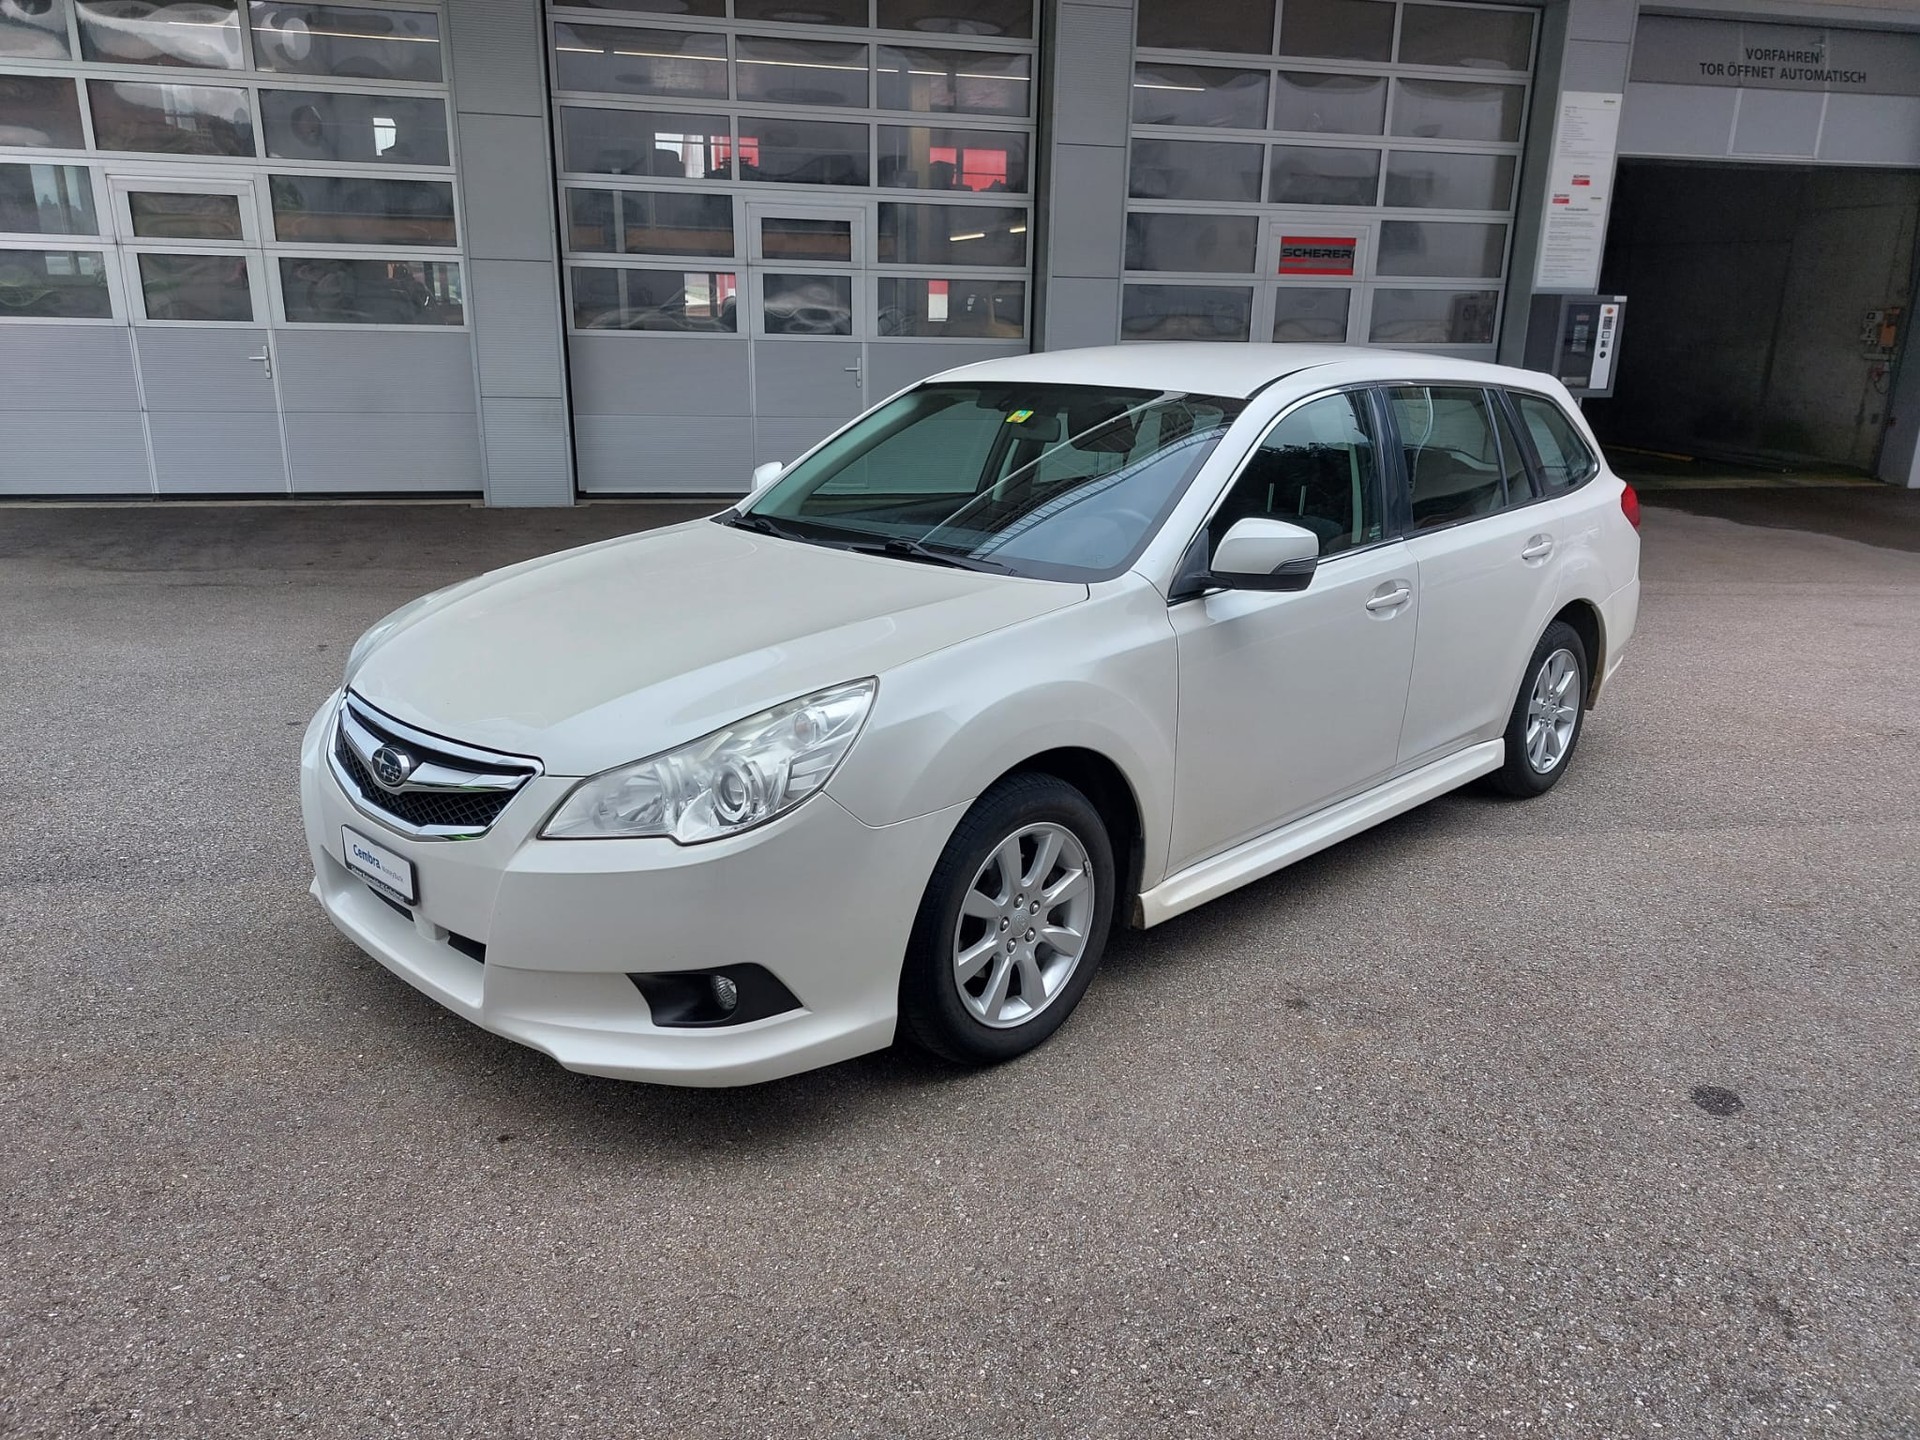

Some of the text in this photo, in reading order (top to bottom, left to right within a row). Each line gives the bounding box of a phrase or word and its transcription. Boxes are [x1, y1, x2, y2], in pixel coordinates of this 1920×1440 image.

[1746, 48, 1819, 64] VORFAHREN
[1700, 61, 1867, 83] TOR ÖFFNET AUTOMATISCH
[1282, 248, 1352, 259] SCHERER
[353, 844, 381, 869] Cembra
